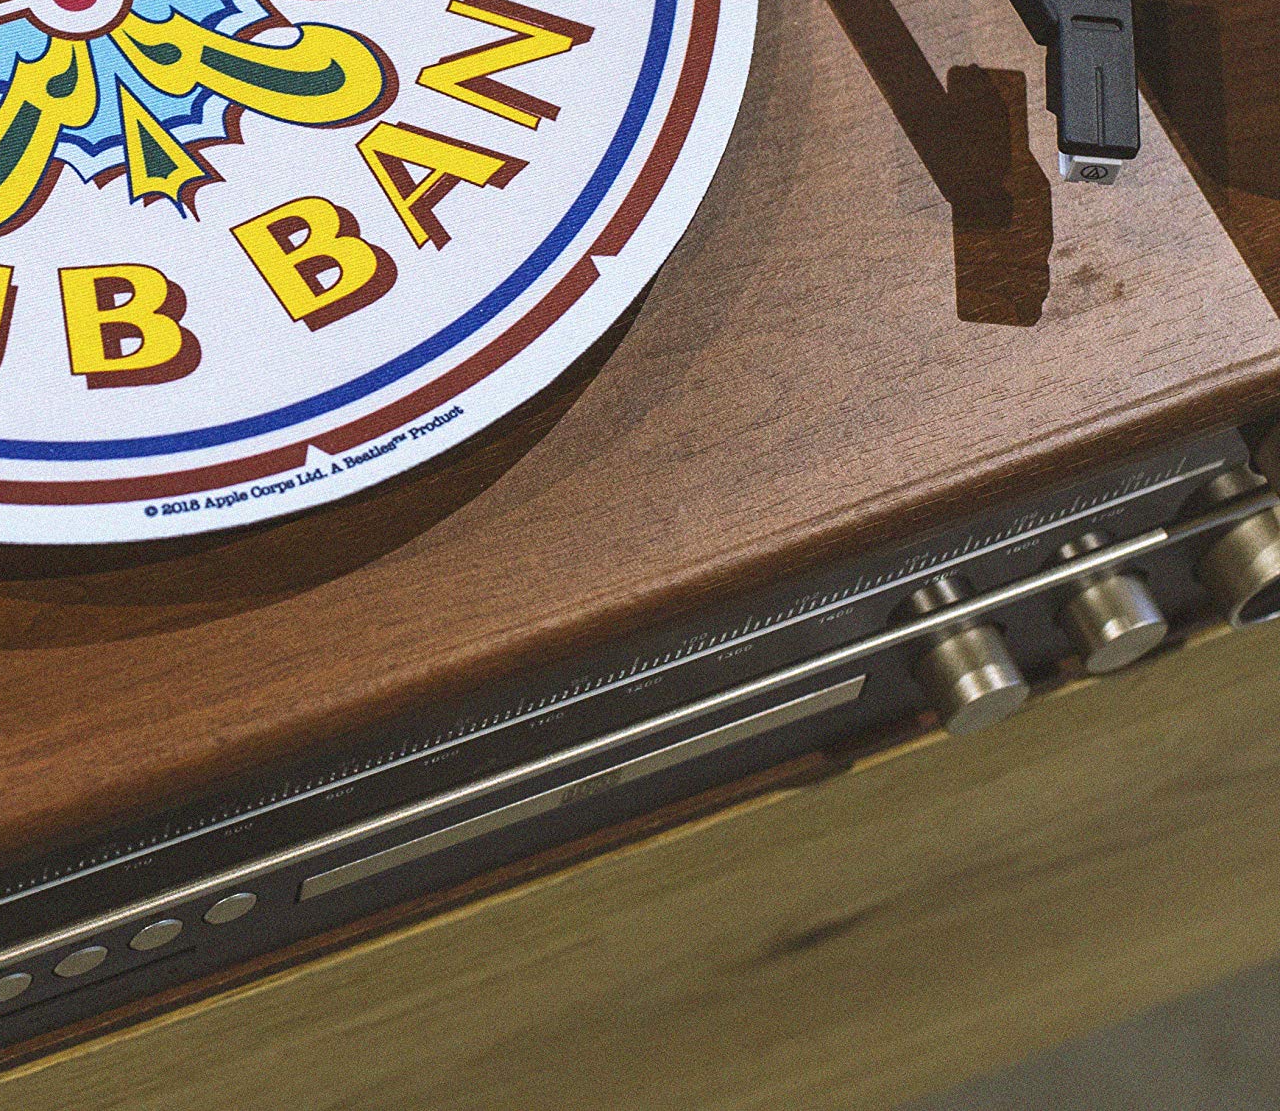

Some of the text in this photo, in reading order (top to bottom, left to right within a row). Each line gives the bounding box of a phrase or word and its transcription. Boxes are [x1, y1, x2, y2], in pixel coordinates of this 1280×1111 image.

[161, 499, 201, 516] 2018
[204, 490, 249, 510] Apple
[251, 477, 296, 500] Corps
[296, 467, 329, 488] Ltd.
[330, 462, 344, 476] A
[408, 404, 465, 441] Product
